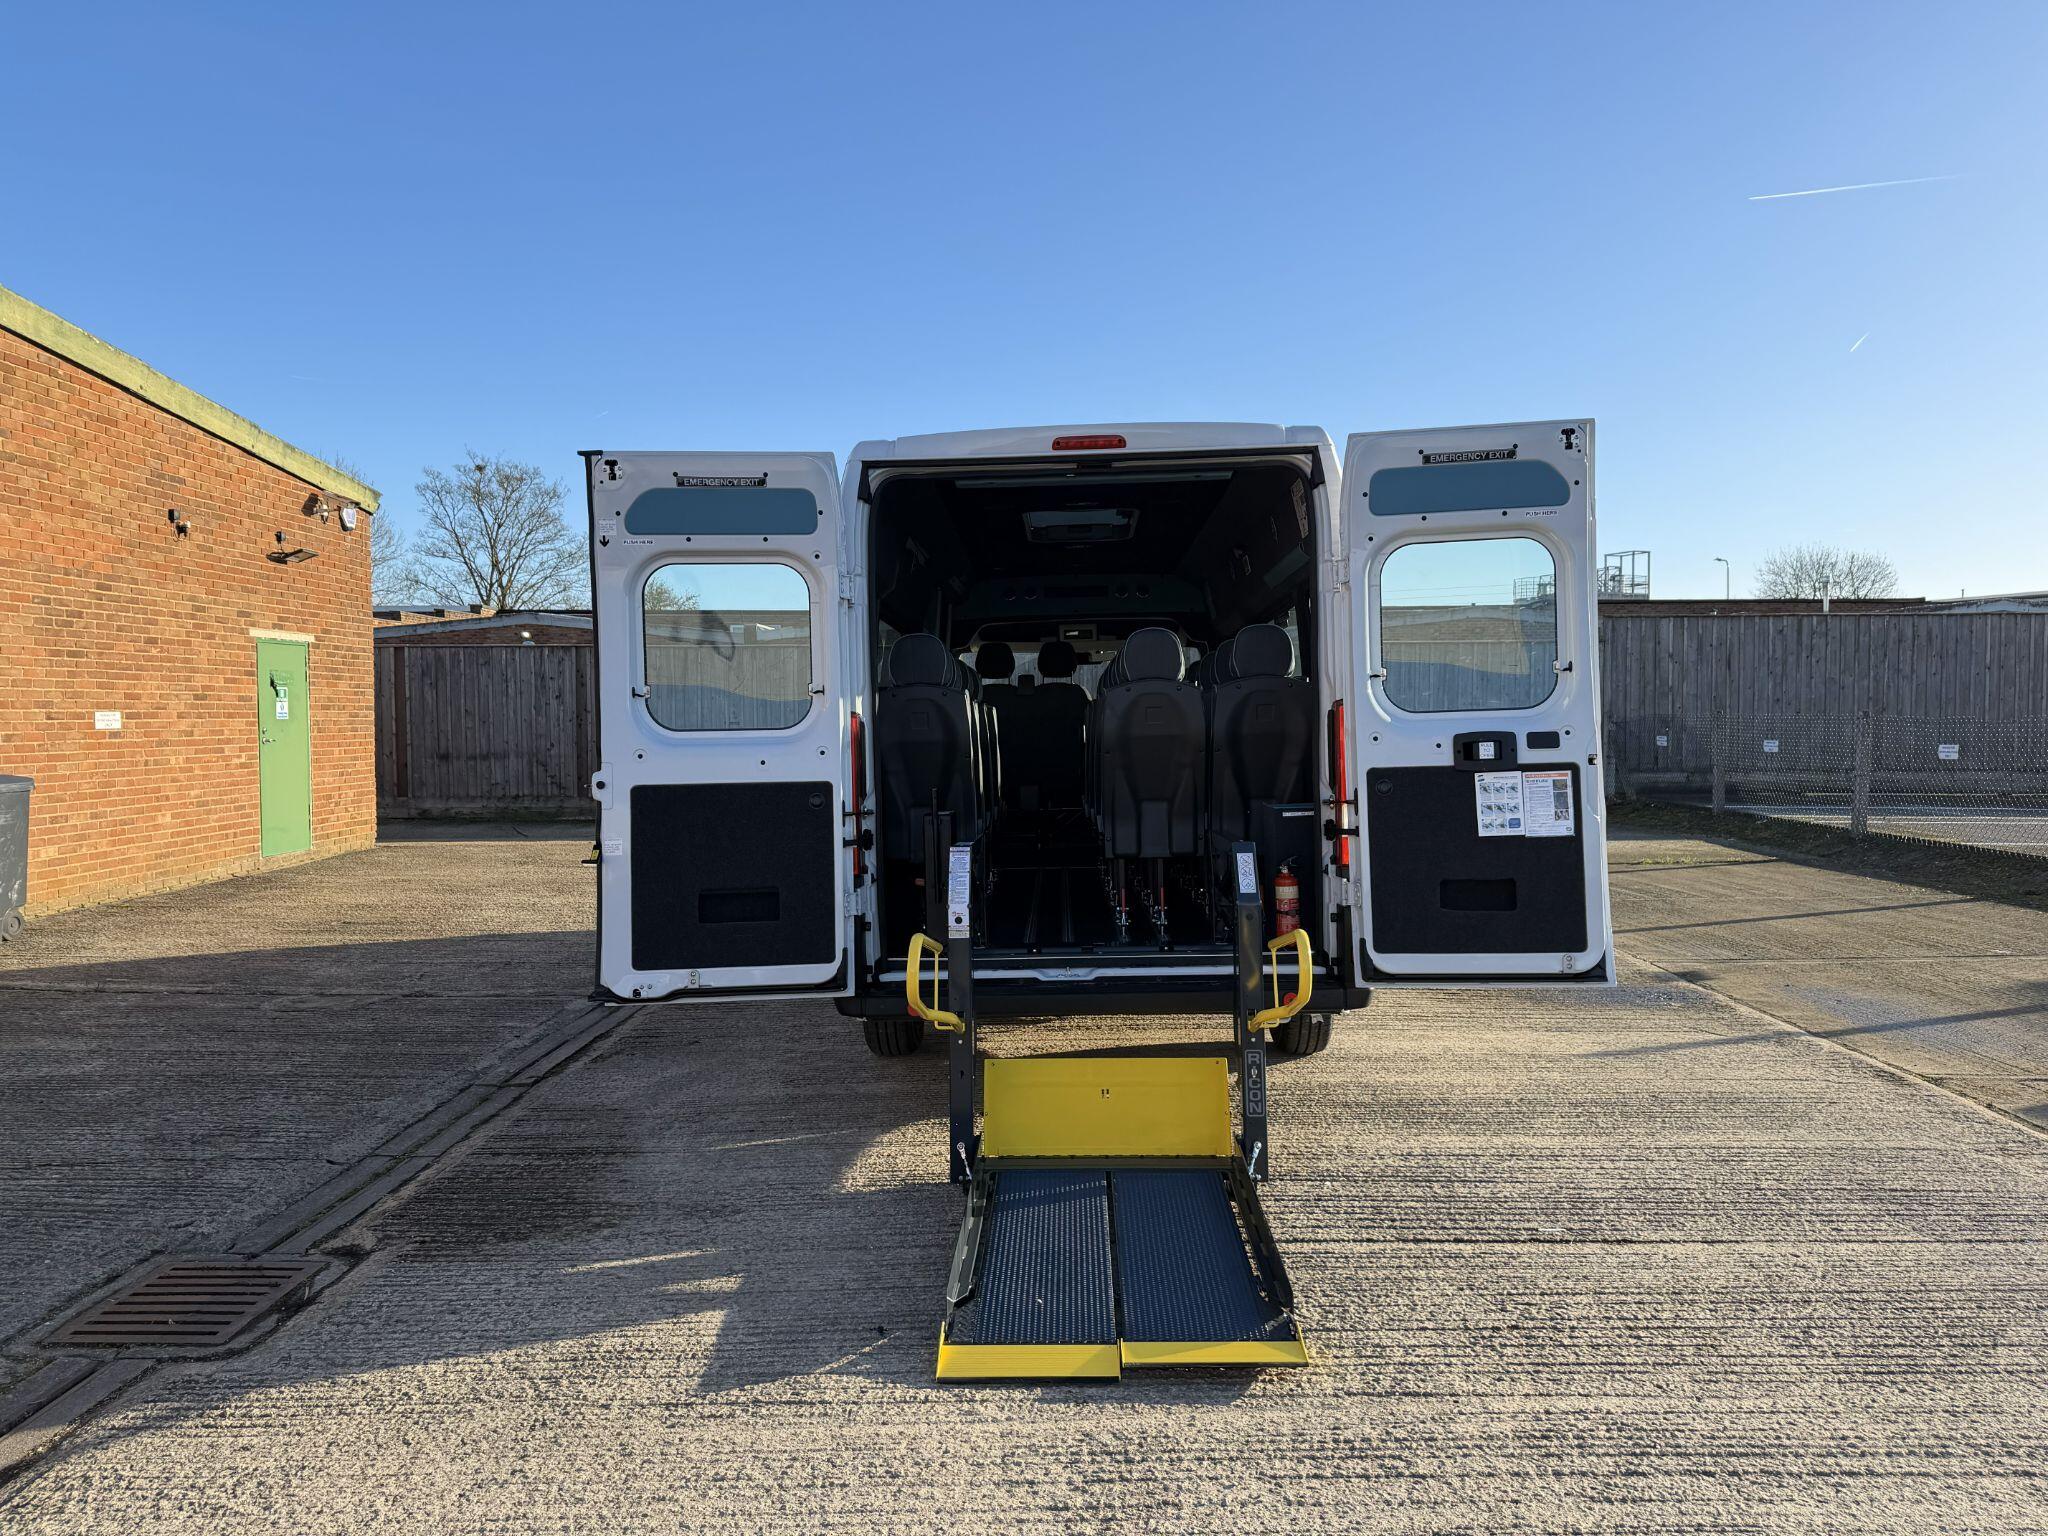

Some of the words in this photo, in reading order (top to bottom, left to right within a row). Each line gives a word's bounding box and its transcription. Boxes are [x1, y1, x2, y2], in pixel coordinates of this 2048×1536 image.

[1430, 452, 1487, 463] EMERGENCY
[1489, 450, 1509, 459] EXIT
[684, 478, 738, 486] EMERGENCY
[740, 478, 759, 486] EXIT
